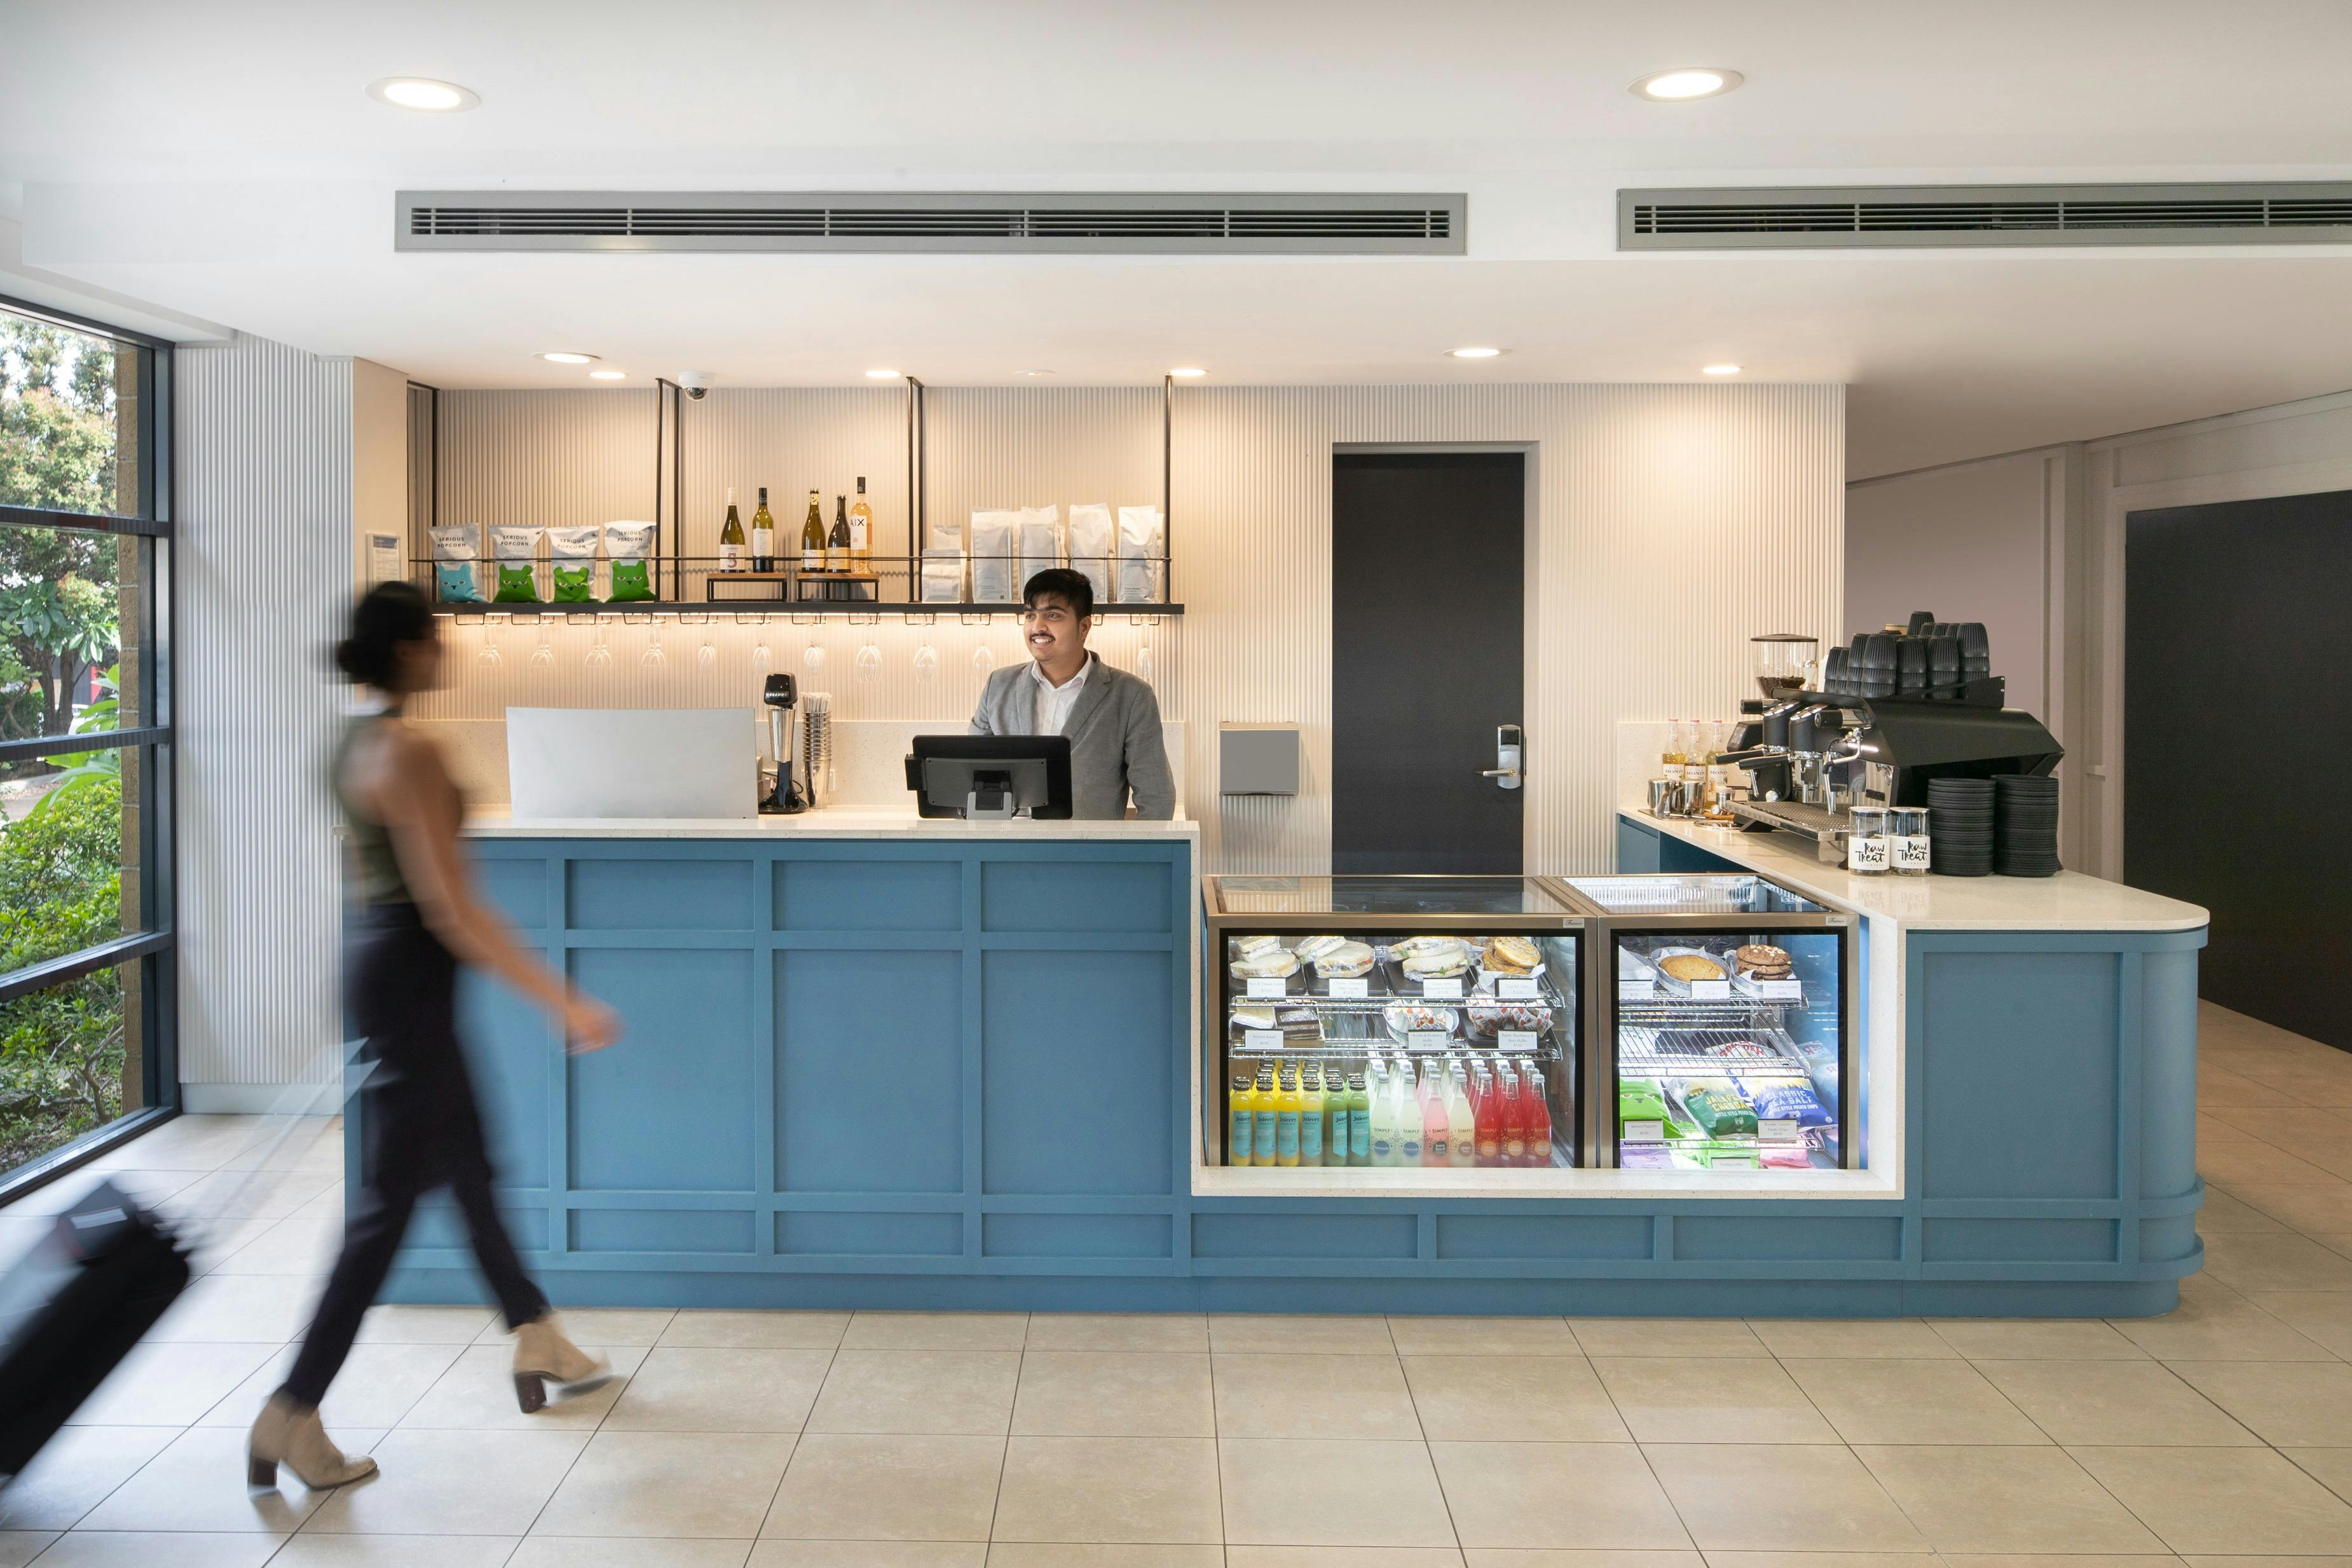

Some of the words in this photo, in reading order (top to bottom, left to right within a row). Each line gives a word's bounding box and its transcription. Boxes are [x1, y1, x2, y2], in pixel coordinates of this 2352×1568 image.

[1767, 1090, 1807, 1100] CLASSIC
[1768, 1098, 1786, 1110] SEA
[1788, 1096, 1812, 1104] SALT
